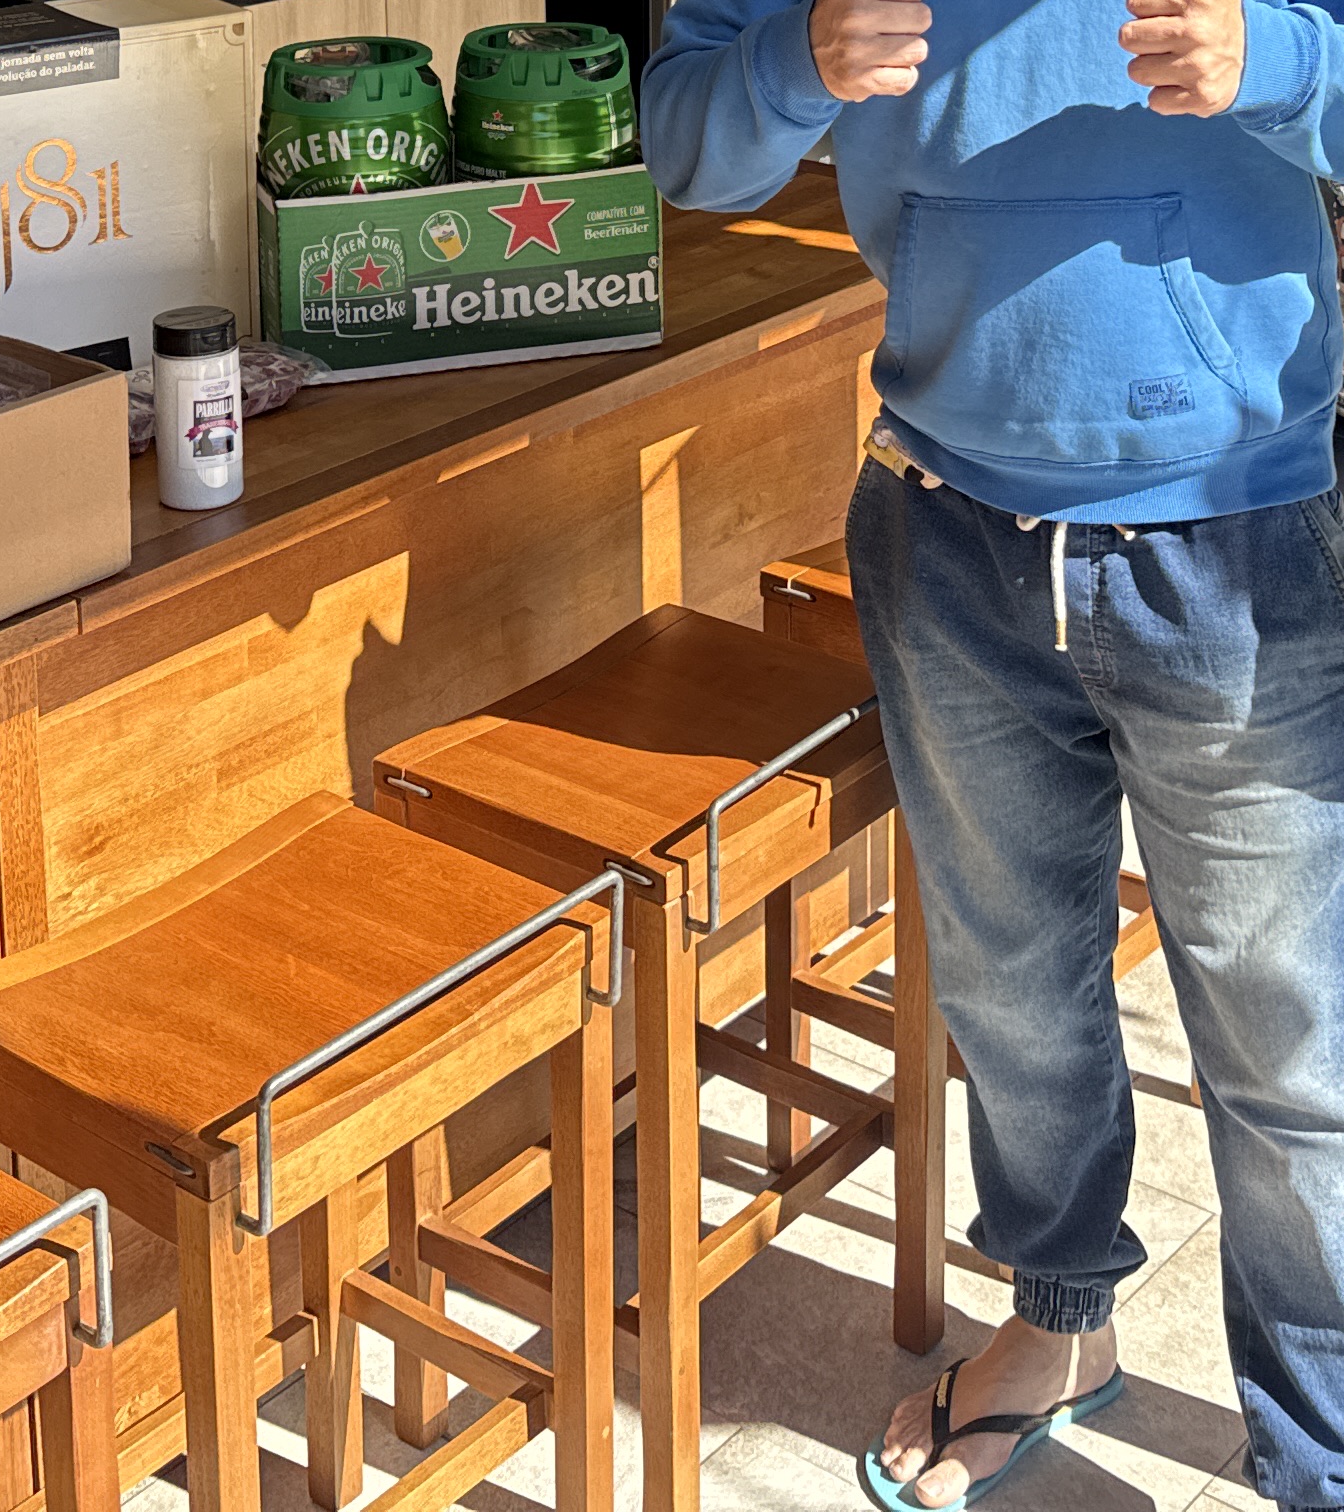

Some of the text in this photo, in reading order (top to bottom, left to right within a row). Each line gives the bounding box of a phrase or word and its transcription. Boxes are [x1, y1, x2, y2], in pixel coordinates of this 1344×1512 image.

[1, 54, 42, 70] jornada
[44, 51, 66, 62] sem
[68, 46, 94, 59] volta
[39, 66, 53, 77] do
[55, 60, 96, 77] paladar.
[629, 205, 645, 216] COM
[584, 222, 649, 240] BeerTender
[412, 268, 658, 331] Heineken
[1138, 384, 1165, 396] COOL
